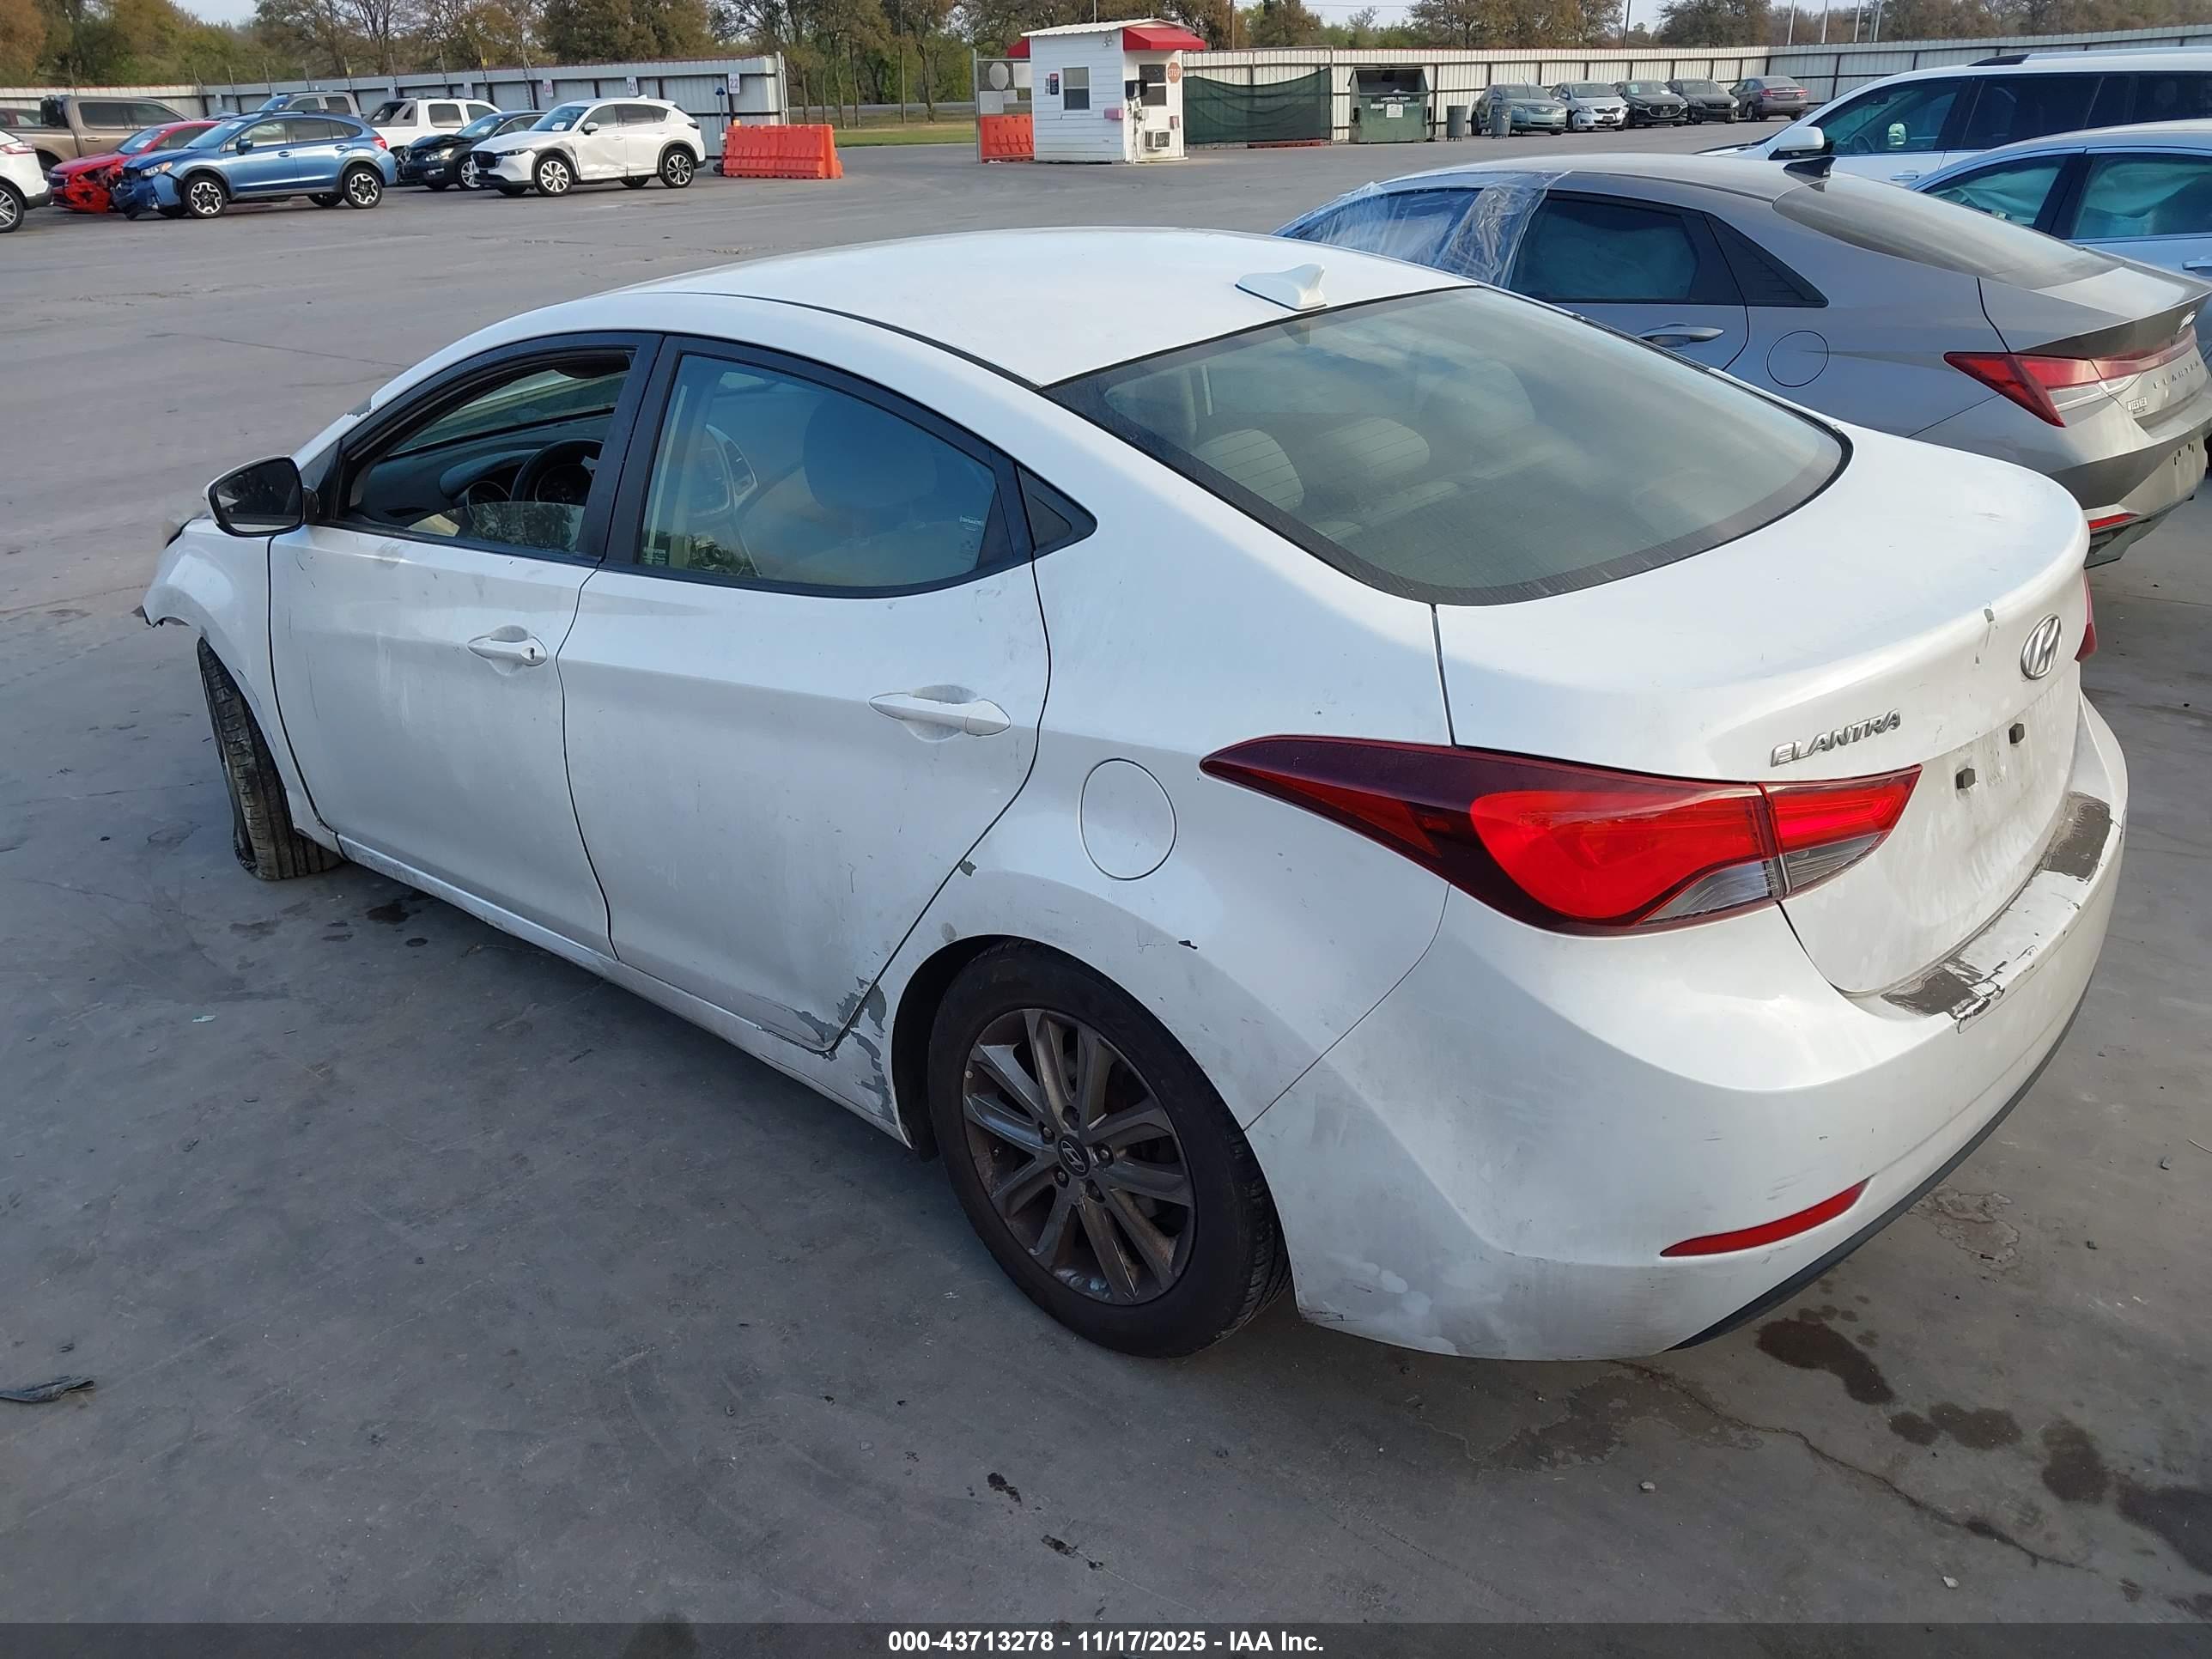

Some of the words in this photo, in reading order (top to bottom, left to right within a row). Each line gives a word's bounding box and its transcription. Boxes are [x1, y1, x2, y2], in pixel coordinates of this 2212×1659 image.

[1168, 68, 1181, 77] STOP
[729, 78, 738, 88] 22
[1771, 708, 1901, 767] ELANTRA
